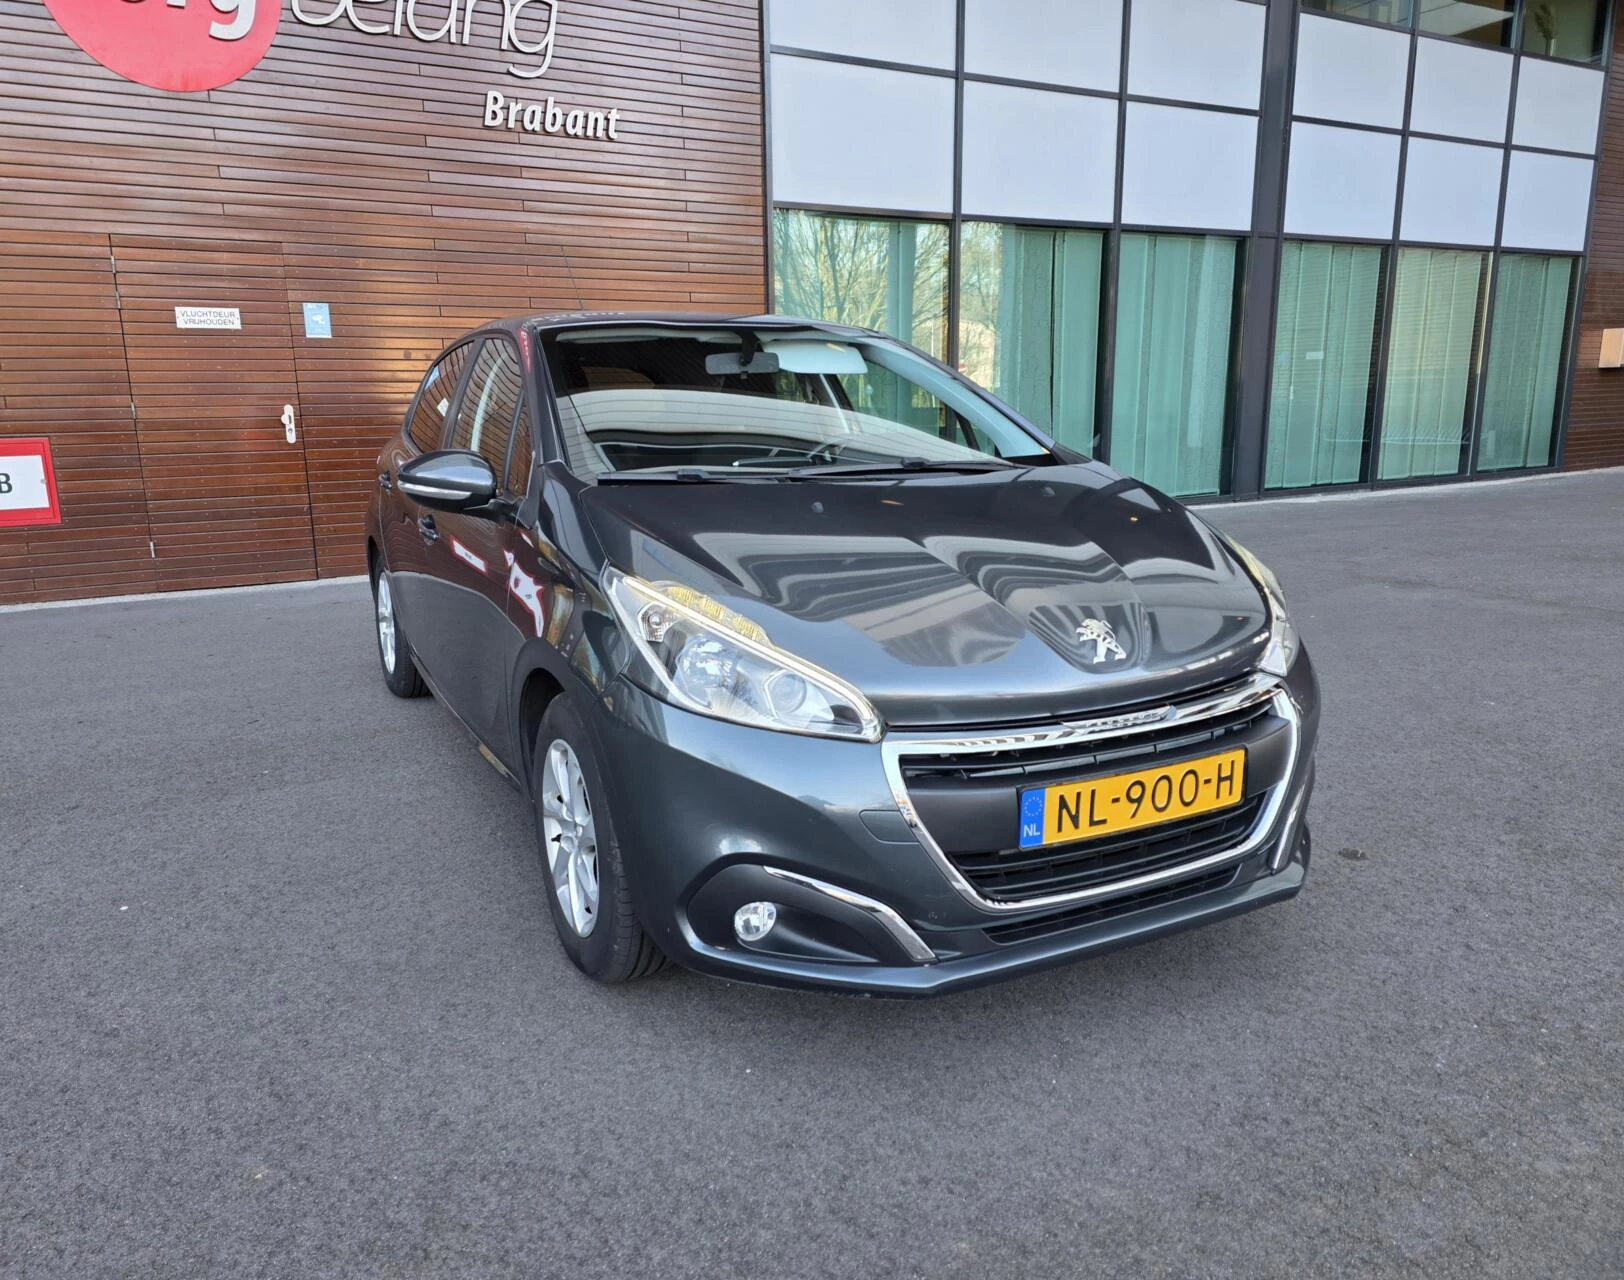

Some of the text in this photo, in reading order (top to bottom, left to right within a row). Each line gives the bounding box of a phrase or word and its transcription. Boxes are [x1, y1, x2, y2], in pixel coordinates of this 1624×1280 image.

[484, 91, 620, 139] Brabant
[180, 310, 236, 318] VLUCHTDEUR
[1057, 760, 1235, 833] NL-900-H
[1023, 824, 1041, 838] NL
